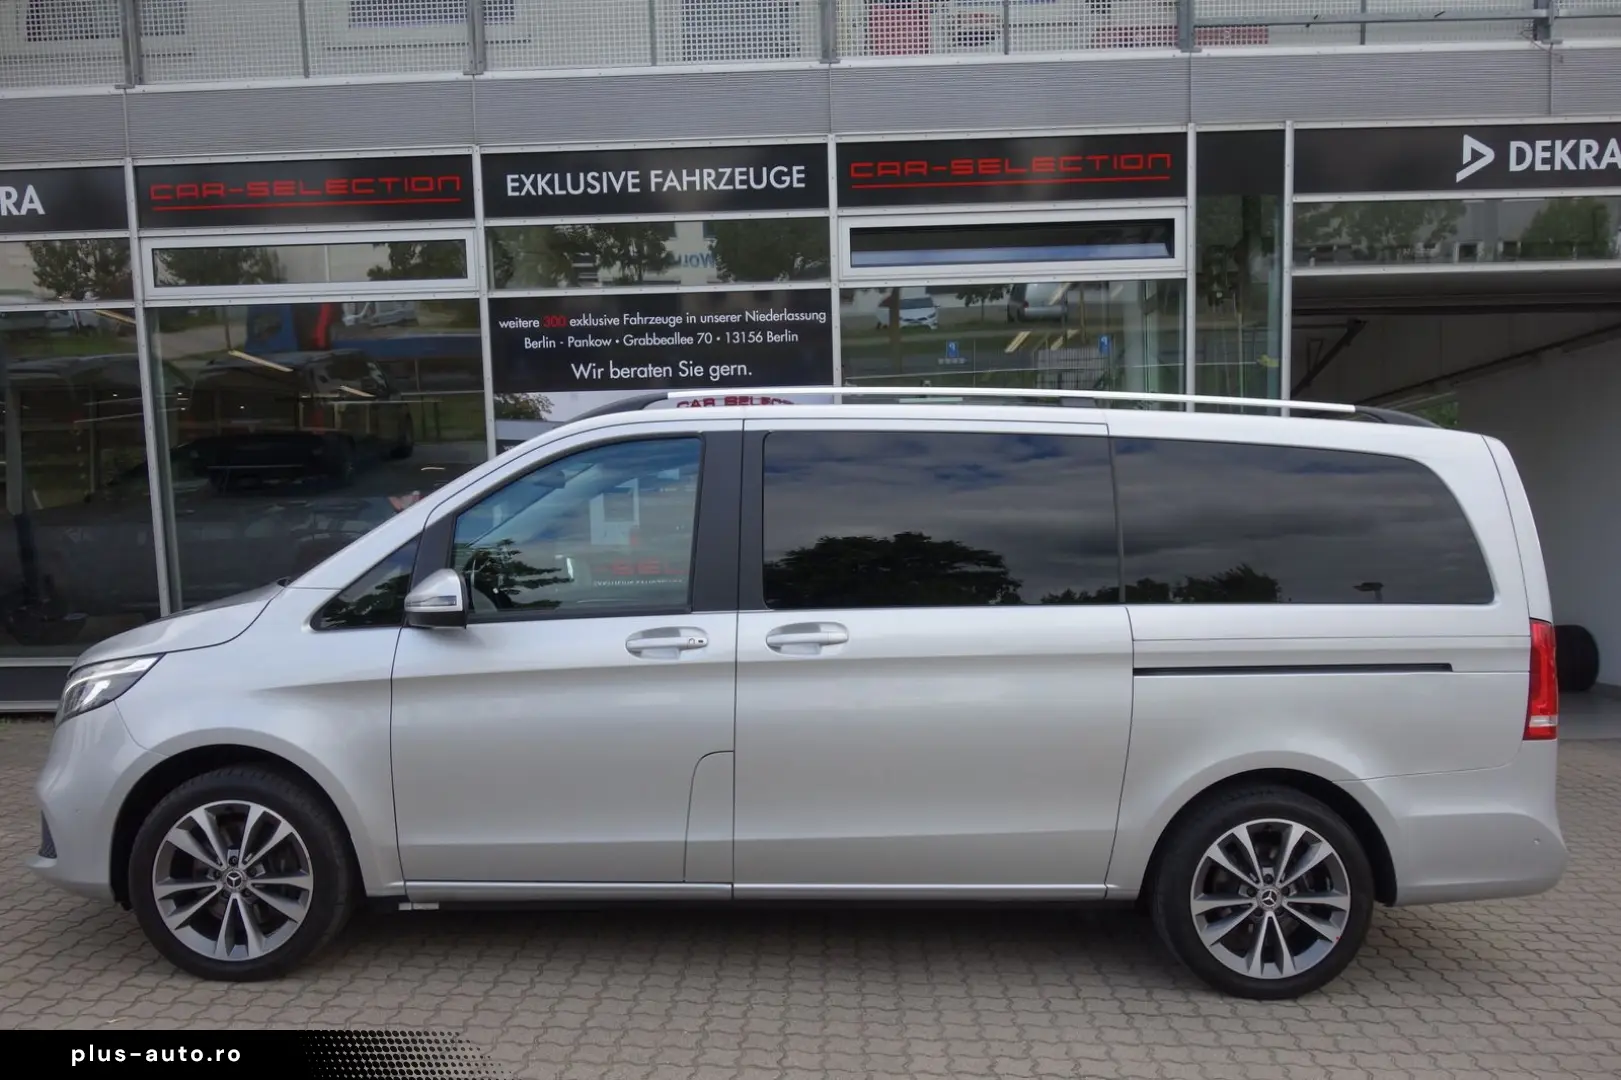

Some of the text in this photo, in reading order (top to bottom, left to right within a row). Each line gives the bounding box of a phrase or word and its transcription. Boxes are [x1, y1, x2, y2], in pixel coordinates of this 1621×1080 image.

[850, 153, 1172, 179] CAR-SELECTION
[1508, 137, 1621, 172] DEKRA
[150, 175, 462, 200] CAR-SELECTION
[506, 165, 806, 197] EXKLUSIVE FAHRZEUGE
[498, 308, 827, 329] weitere 300 exklusive Fahrzeuge in unserer Niederlassung
[524, 335, 556, 349] Berlin
[567, 334, 612, 348] Pankow
[622, 332, 694, 346] Grabbeallee
[697, 332, 713, 344] 70
[725, 331, 763, 343] 13156
[766, 329, 799, 343] Berlin
[571, 360, 752, 382] Wir beraten Sie gern.
